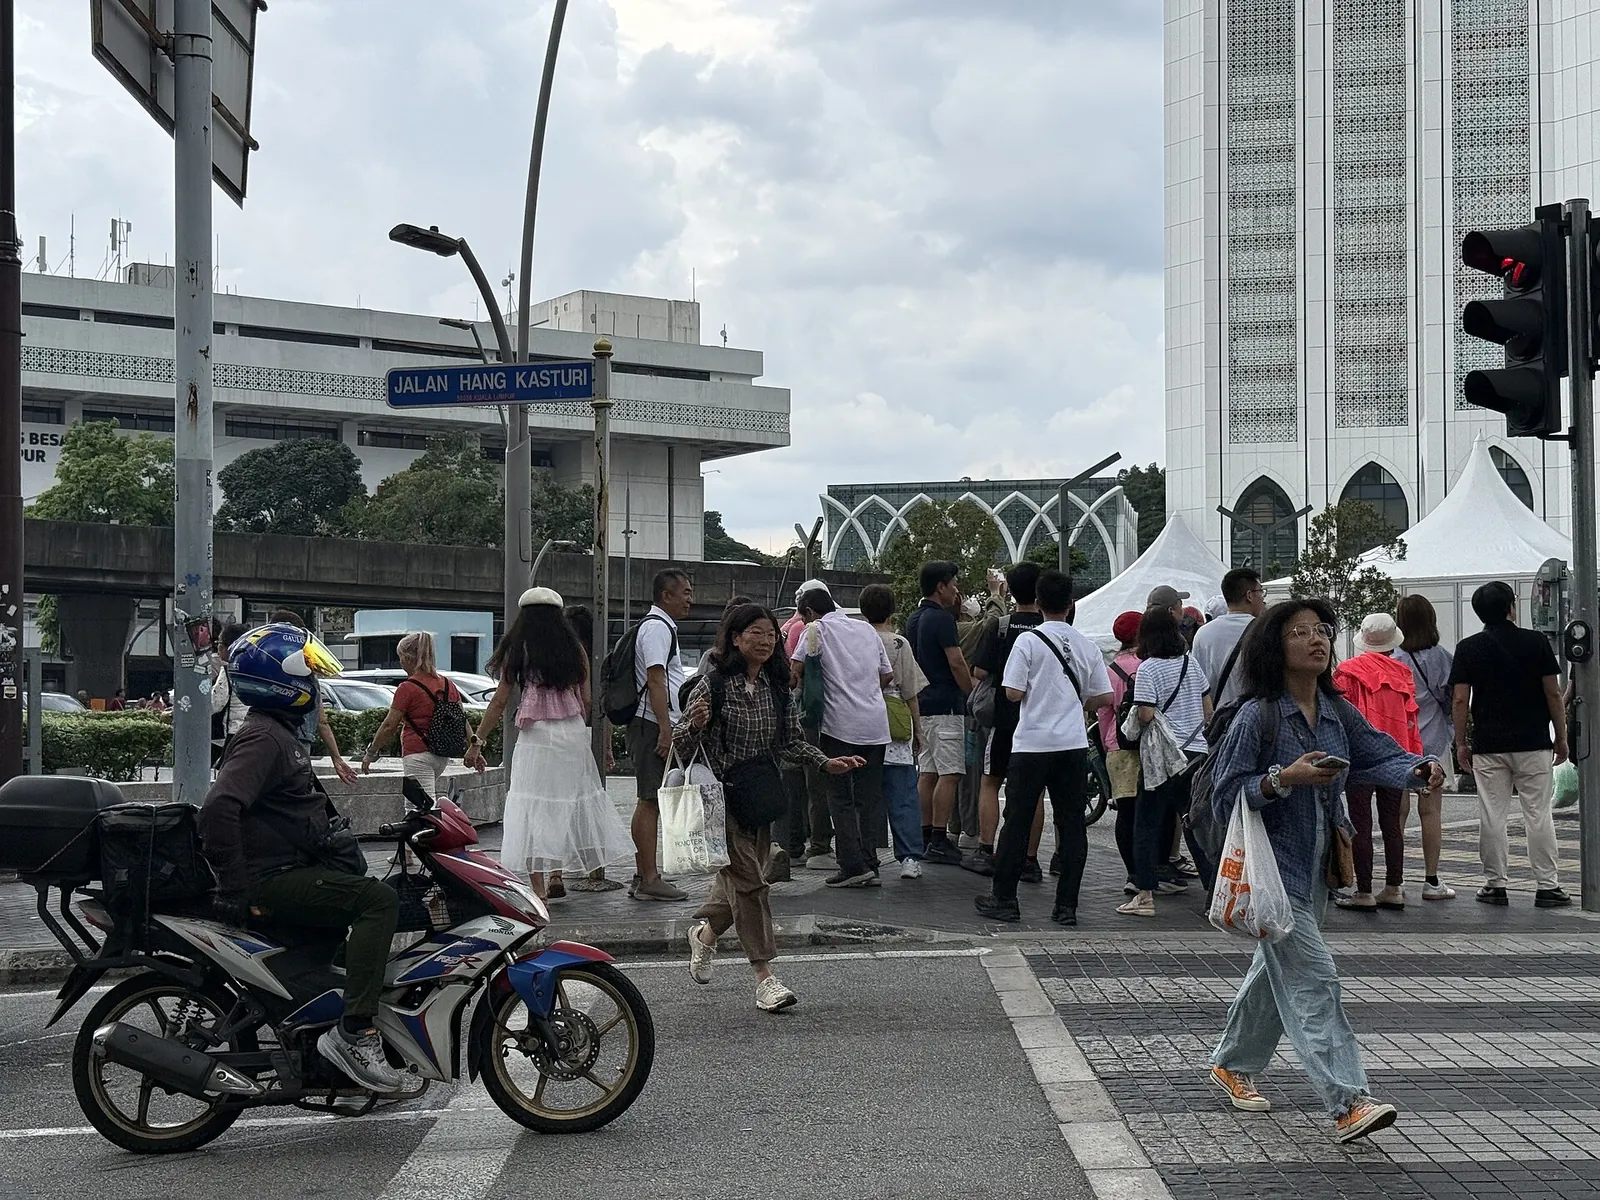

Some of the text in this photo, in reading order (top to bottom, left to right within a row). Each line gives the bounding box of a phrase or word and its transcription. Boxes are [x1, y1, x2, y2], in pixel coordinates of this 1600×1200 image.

[394, 368, 588, 394] JALAN HANG KASTURI
[21, 449, 46, 463] UR
[488, 927, 515, 936] HONDA
[346, 1046, 370, 1069] HOKA
